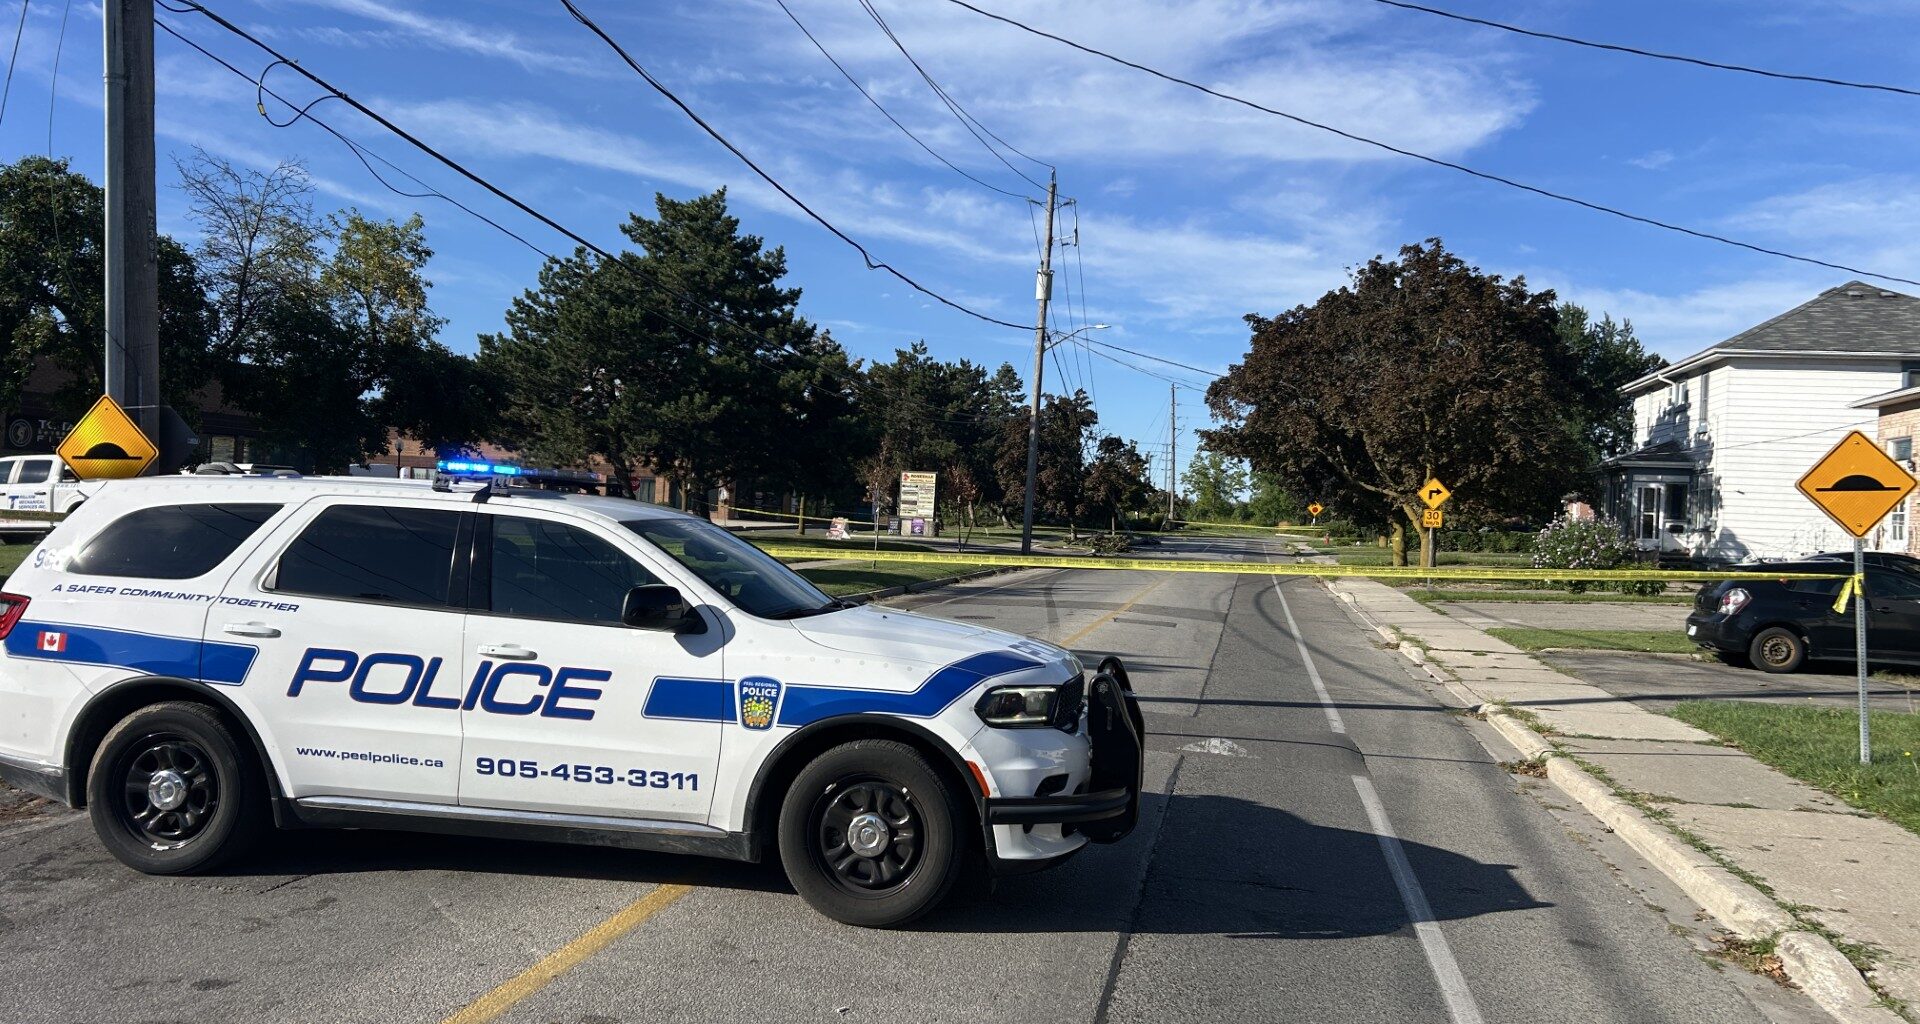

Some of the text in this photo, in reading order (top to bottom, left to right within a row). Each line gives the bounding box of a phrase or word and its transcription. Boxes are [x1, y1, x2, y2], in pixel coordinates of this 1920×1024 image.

[1426, 511, 1440, 520] 30
[51, 584, 300, 613] A SAFER COMMUNITY TOGETHER
[286, 647, 613, 721] POLICE
[742, 686, 778, 697] POLICE
[296, 746, 444, 768] www.peelpolice.ca
[475, 757, 699, 791] 905-453-3311
